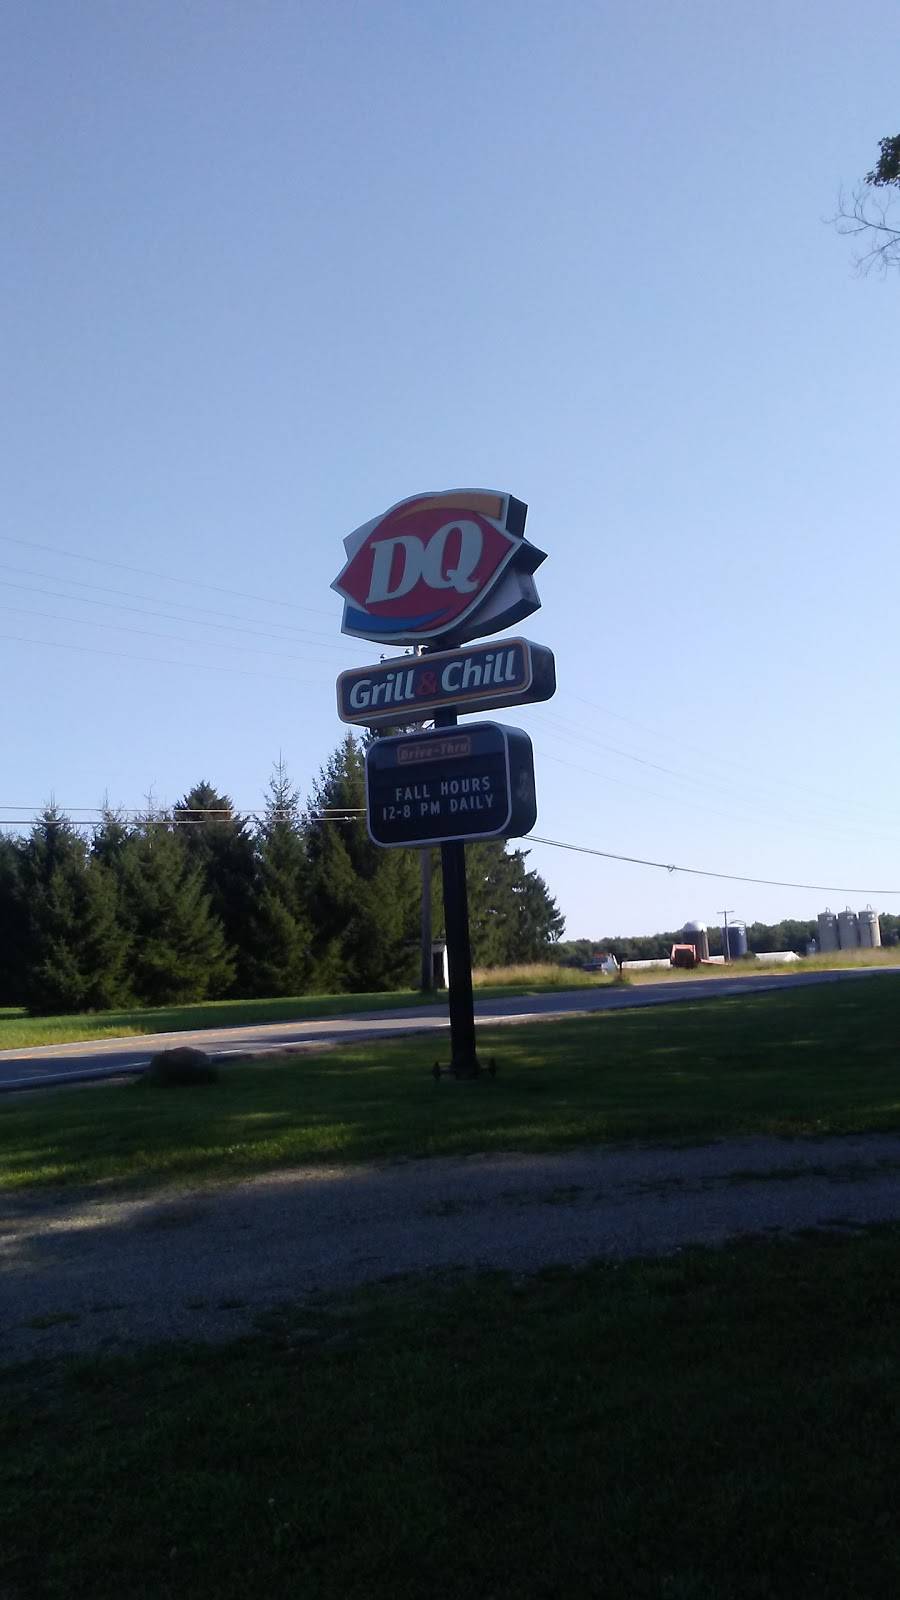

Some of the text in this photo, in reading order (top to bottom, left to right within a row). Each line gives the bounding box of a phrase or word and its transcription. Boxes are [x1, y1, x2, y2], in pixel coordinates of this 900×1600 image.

[366, 519, 483, 604] DQ
[349, 649, 516, 710] Grill & Chill
[402, 742, 468, 759] Drive-Thru
[395, 776, 491, 802] FALL HOURS
[383, 793, 494, 821] 12-8 PM DAILY
